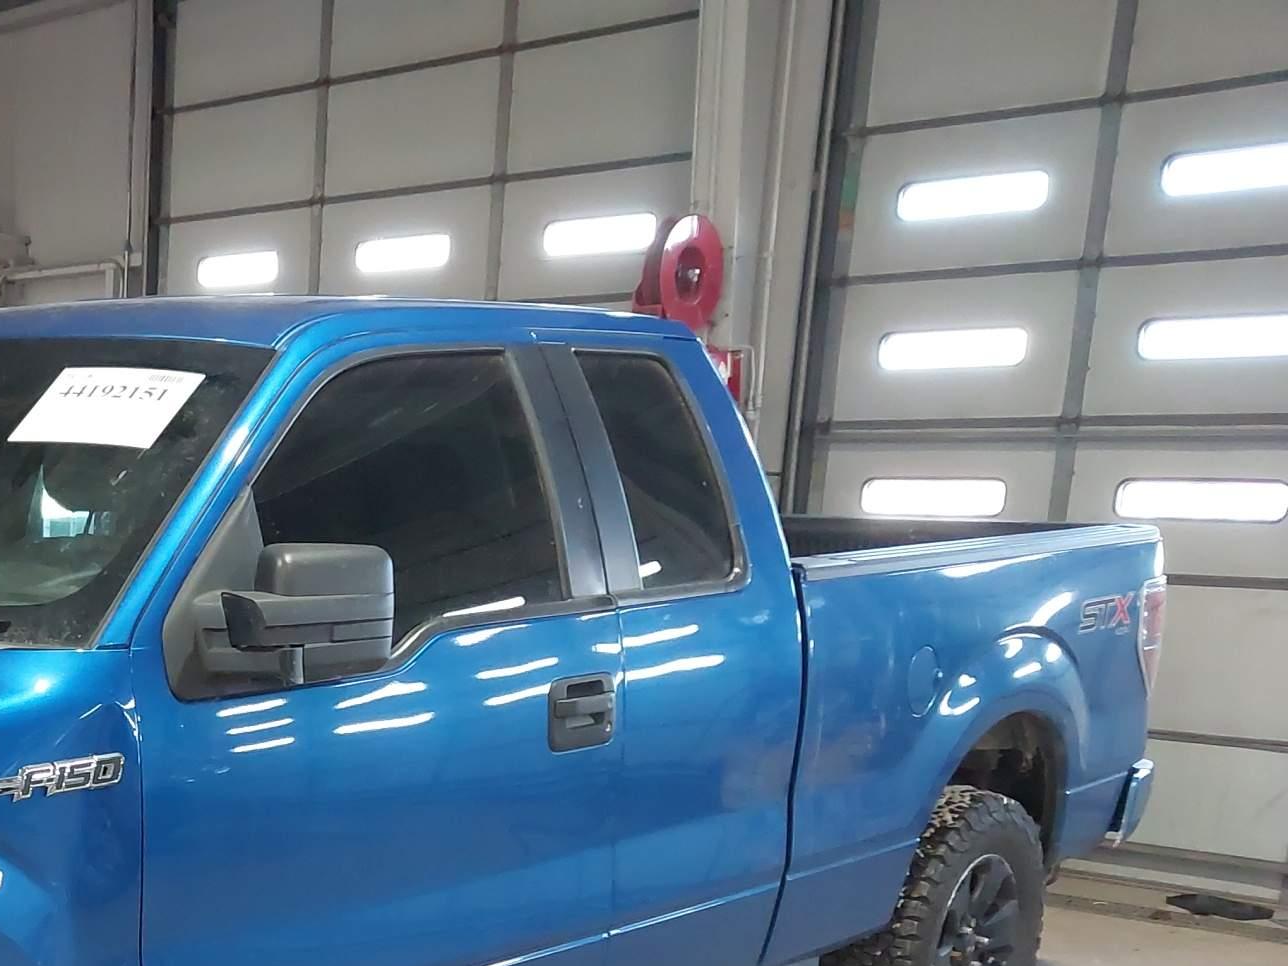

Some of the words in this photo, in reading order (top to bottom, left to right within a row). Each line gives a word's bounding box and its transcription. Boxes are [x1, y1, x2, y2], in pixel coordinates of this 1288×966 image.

[59, 385, 169, 401] 44192151
[1079, 592, 1134, 633] STX
[13, 752, 125, 802] F-150
